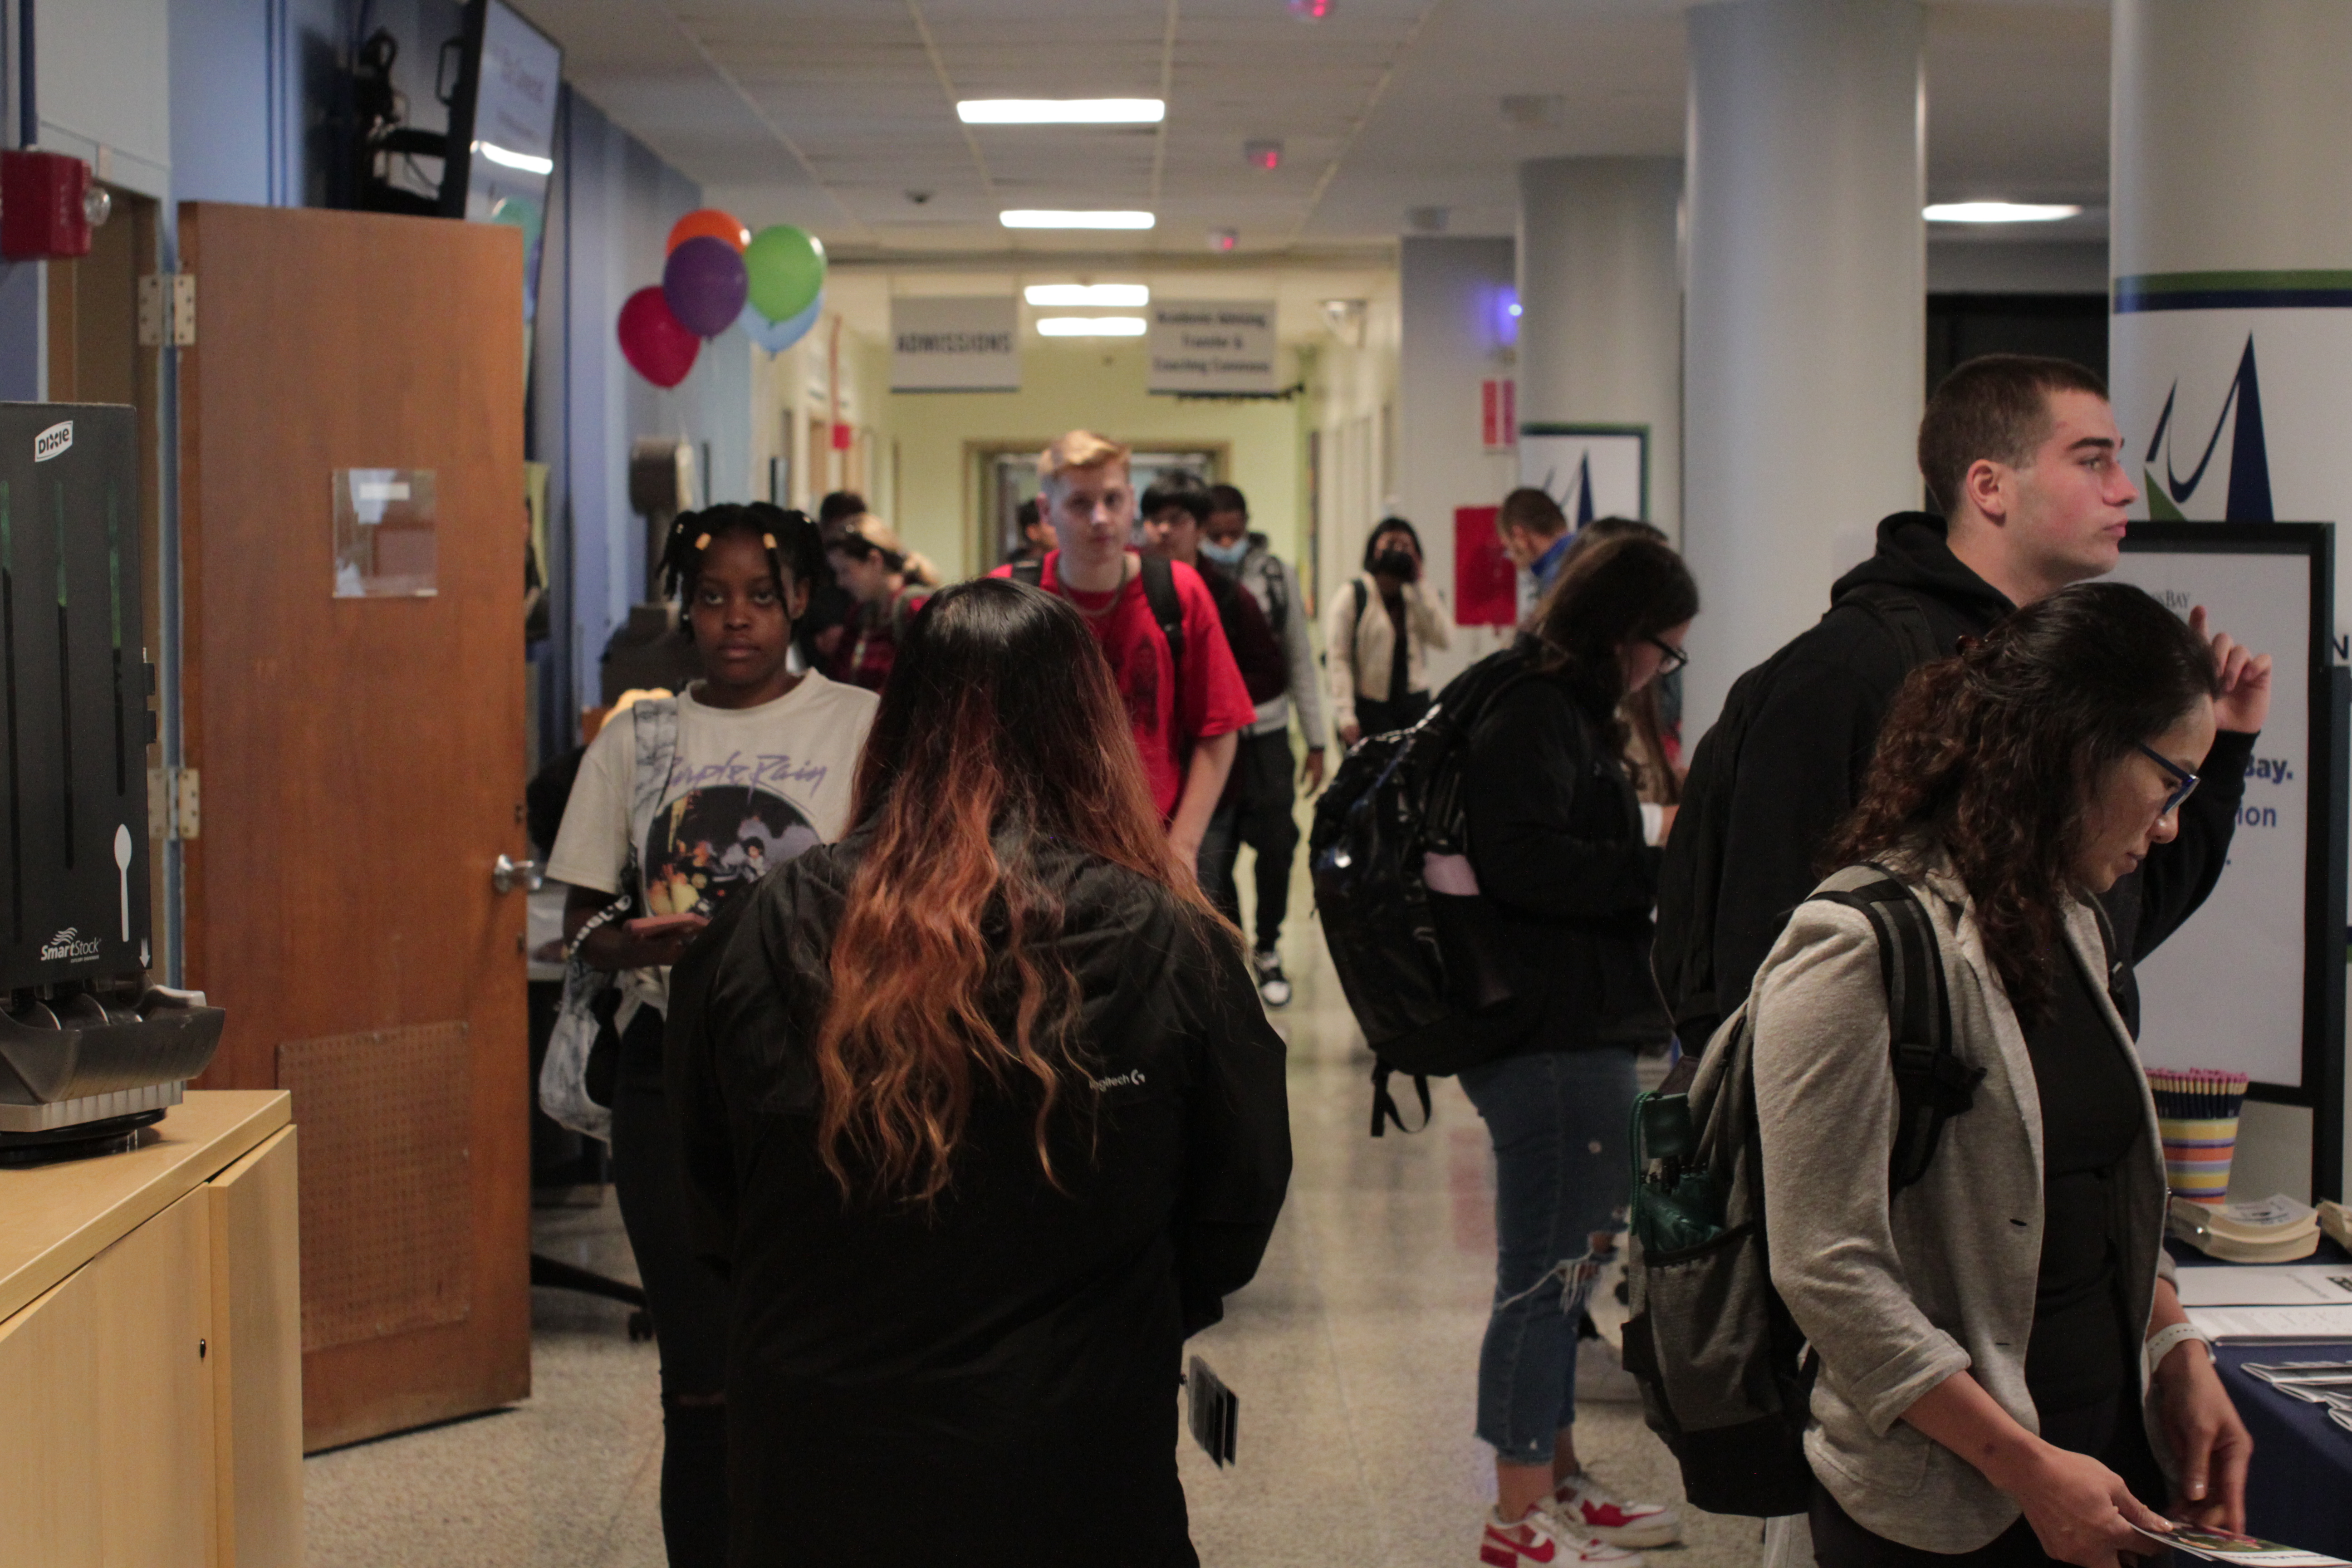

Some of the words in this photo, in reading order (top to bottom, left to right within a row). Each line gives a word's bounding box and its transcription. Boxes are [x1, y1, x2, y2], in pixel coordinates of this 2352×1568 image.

[897, 333, 1011, 353] ADMISSIONS
[671, 751, 749, 789] urple
[40, 937, 98, 961] SmartStock
